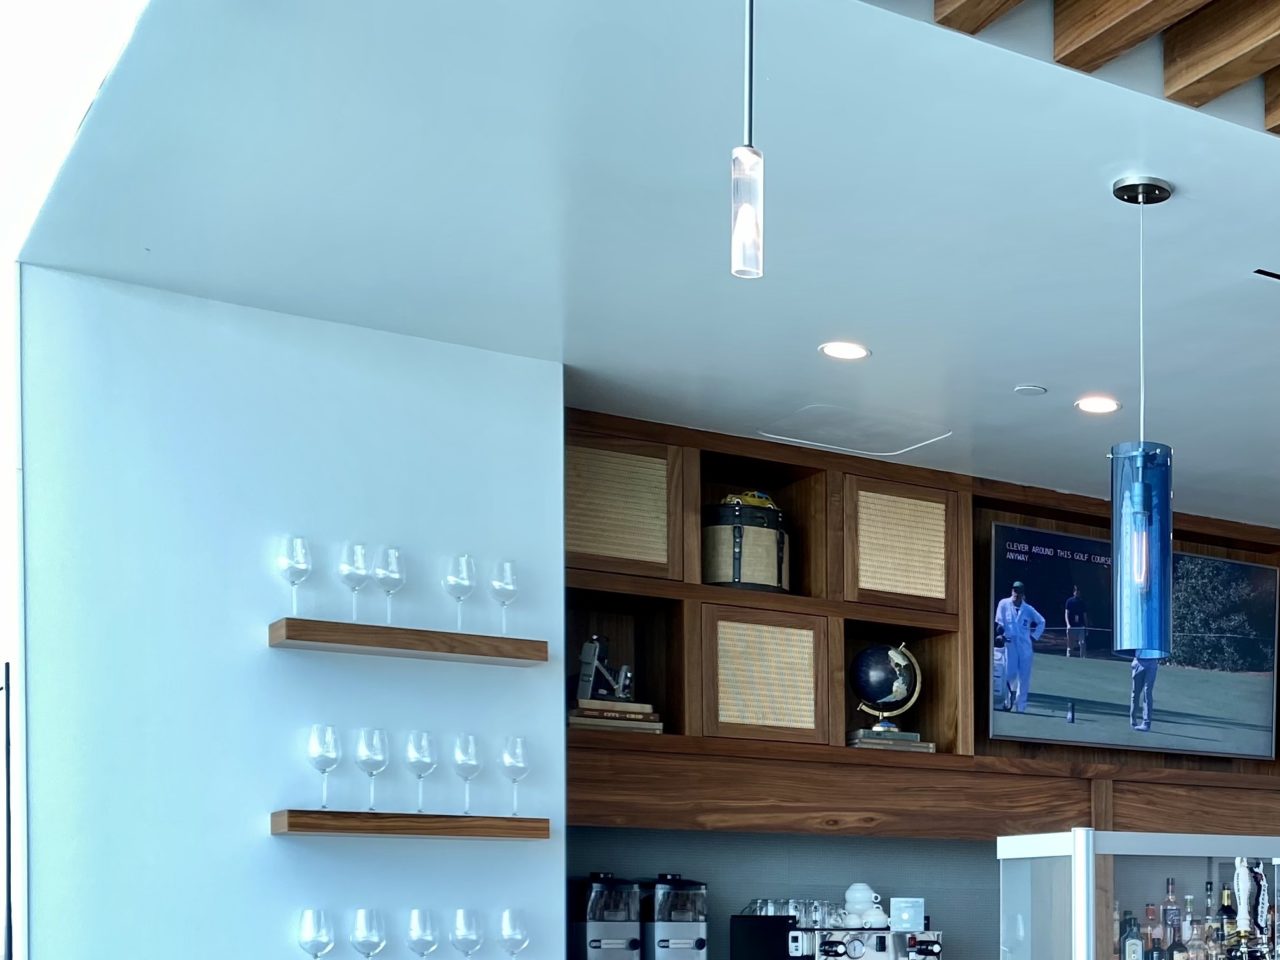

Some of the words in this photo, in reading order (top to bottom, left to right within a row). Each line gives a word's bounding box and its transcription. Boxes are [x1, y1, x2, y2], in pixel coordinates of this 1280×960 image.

[1006, 541, 1029, 552] CLEVER
[1031, 545, 1054, 556] AROUND
[1057, 549, 1072, 559] THIS
[1073, 552, 1089, 561] GOLF
[1091, 554, 1112, 565] COURSE
[1006, 551, 1029, 562] ANYWAY
